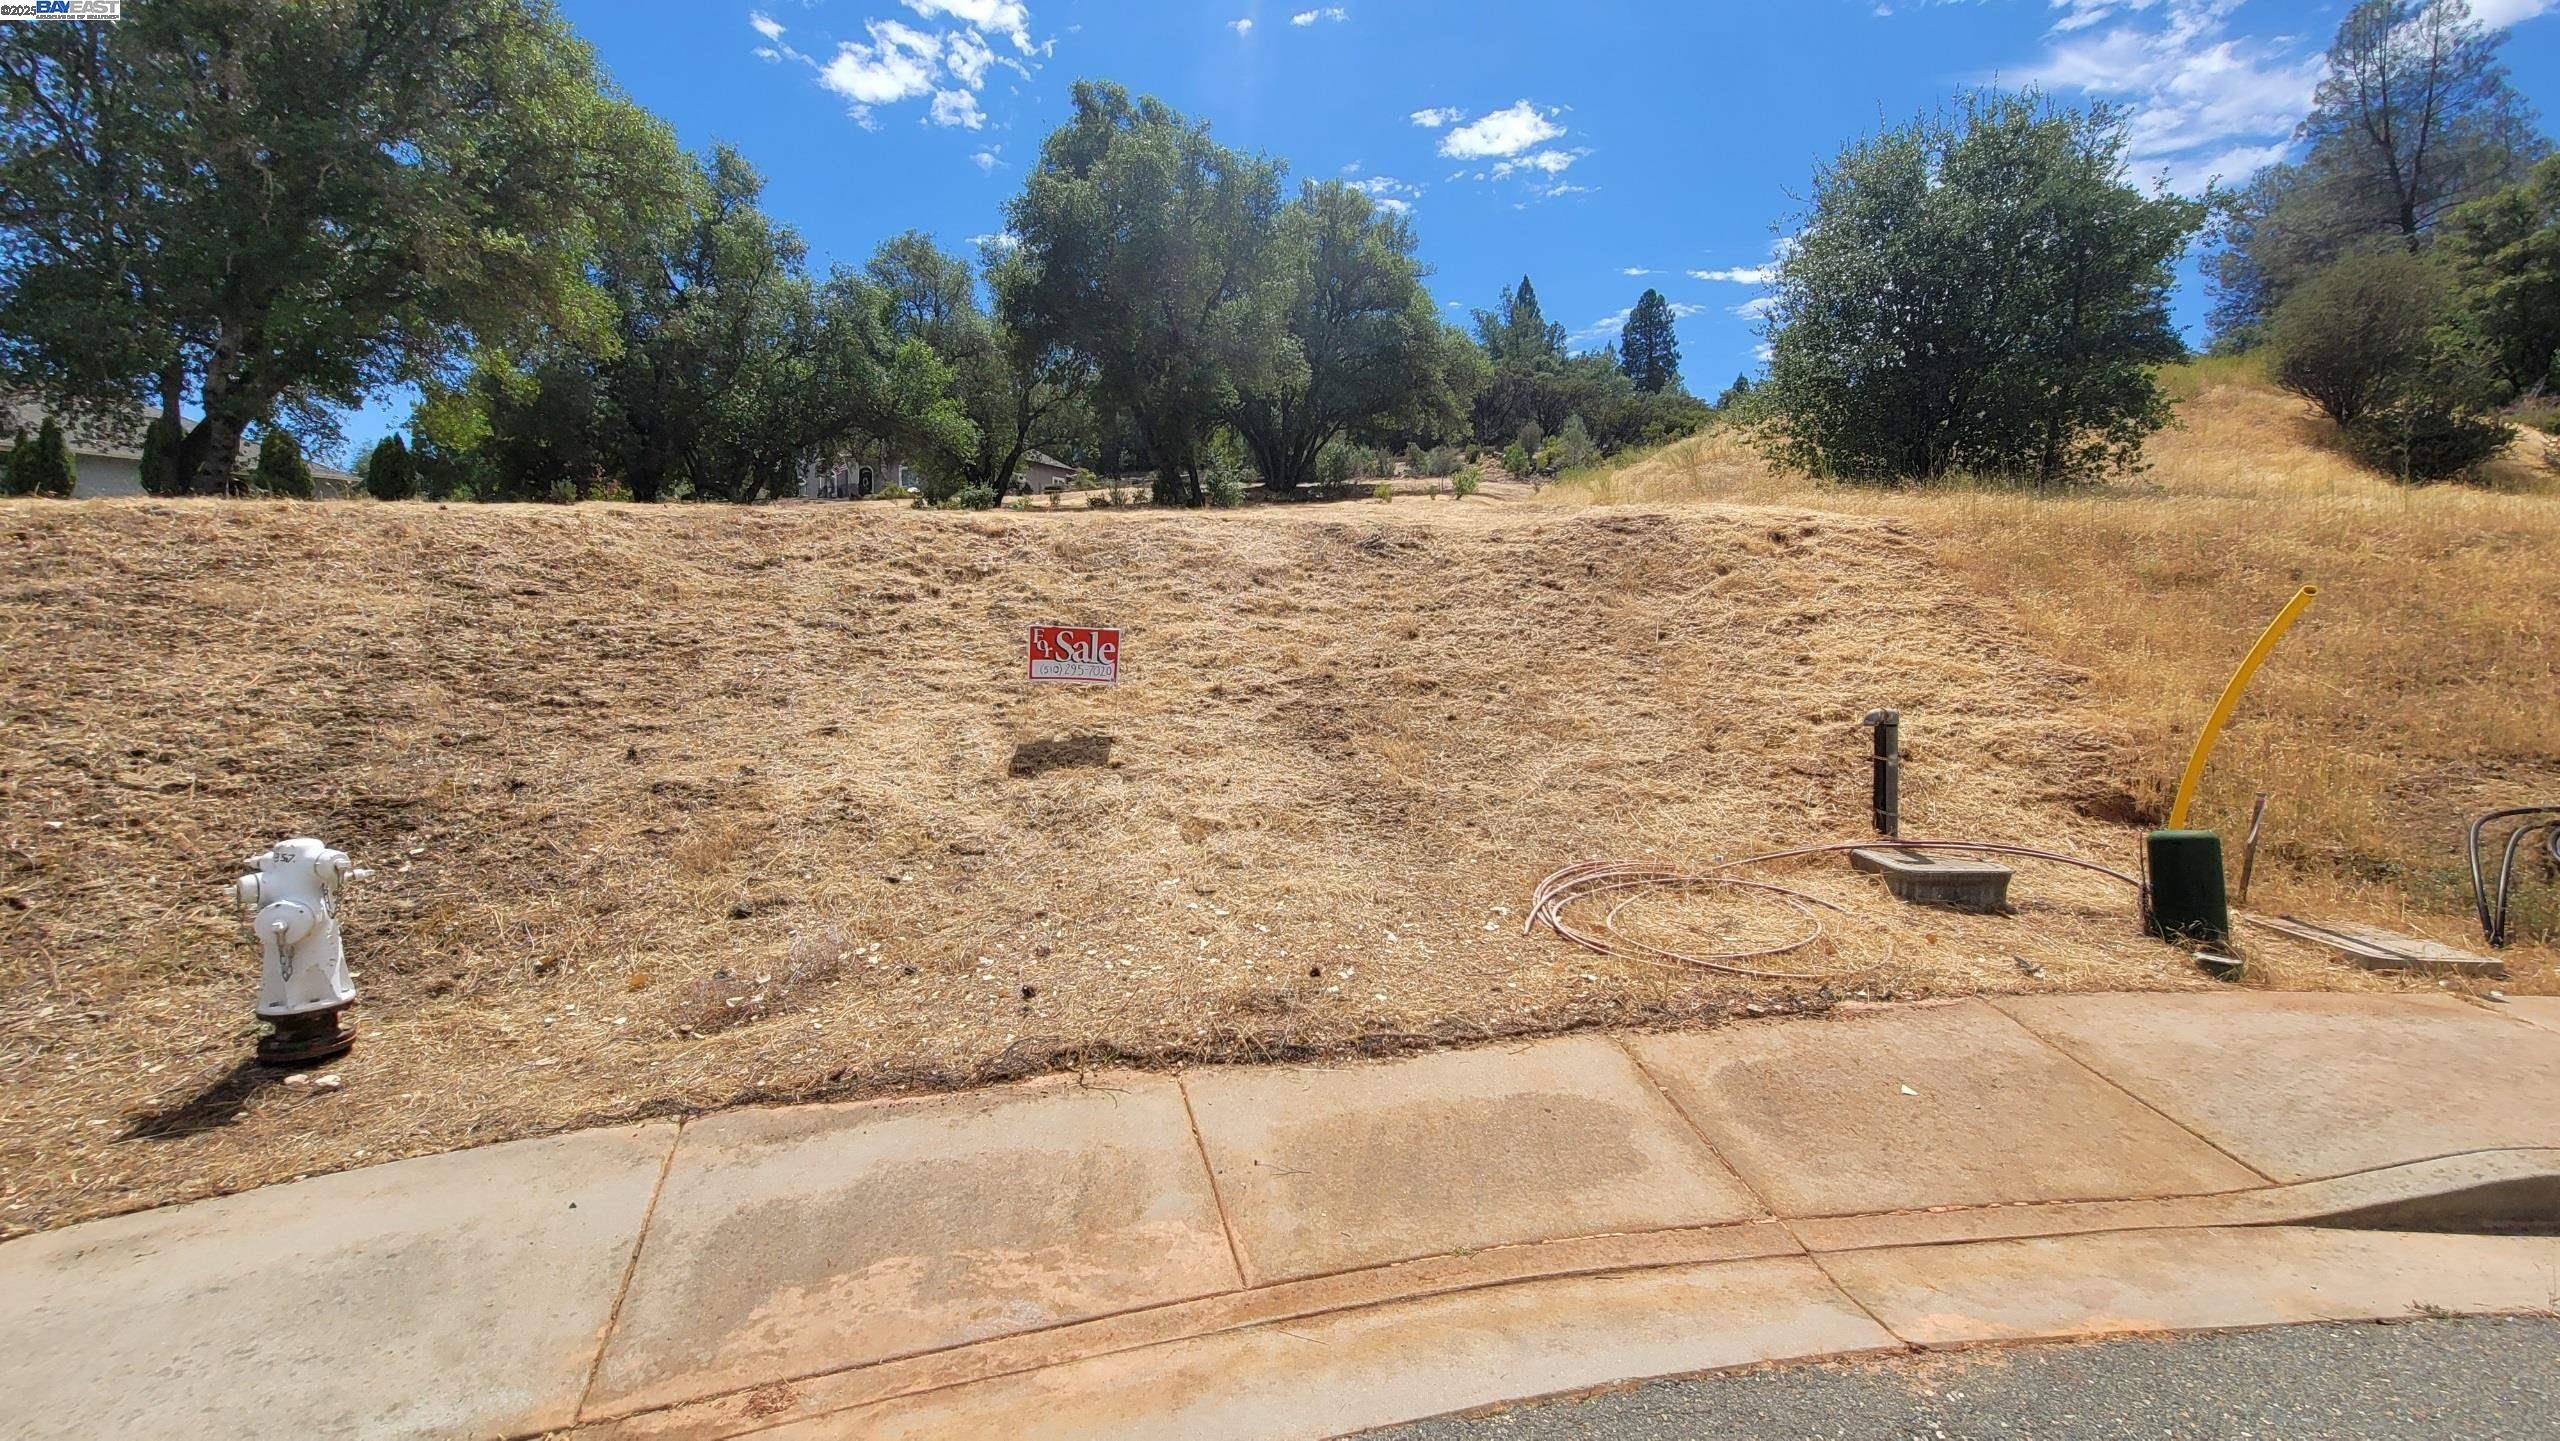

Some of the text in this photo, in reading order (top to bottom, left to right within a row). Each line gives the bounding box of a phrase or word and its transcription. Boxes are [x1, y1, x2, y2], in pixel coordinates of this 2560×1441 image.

[1033, 628, 1116, 665] For Sale
[1040, 663, 1112, 677] (510) 295-7020
